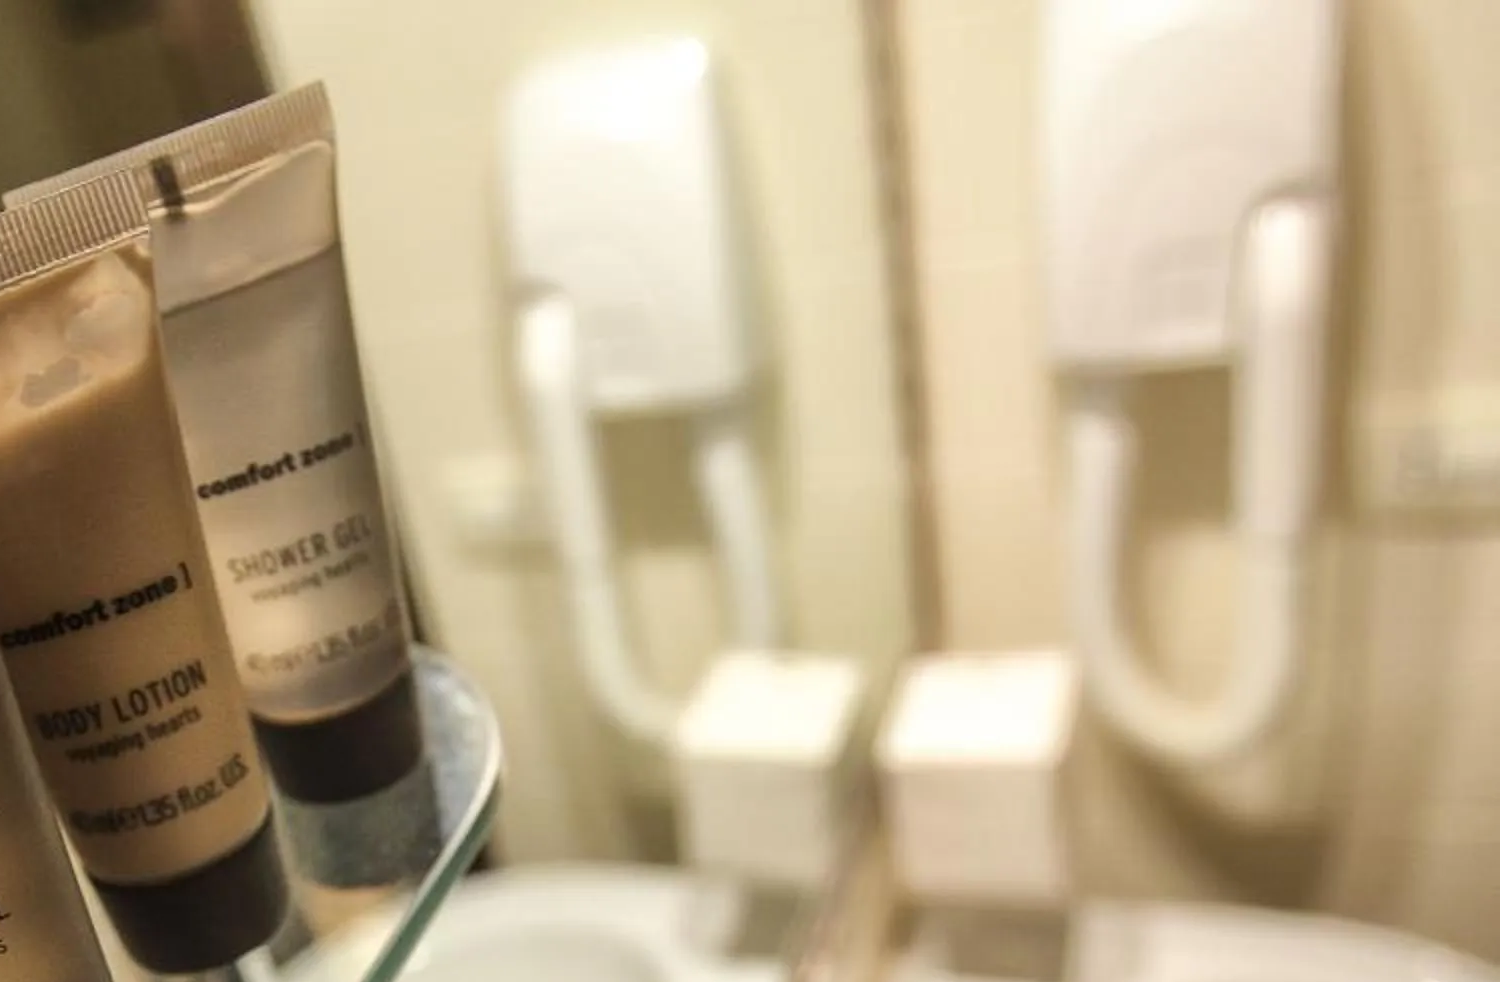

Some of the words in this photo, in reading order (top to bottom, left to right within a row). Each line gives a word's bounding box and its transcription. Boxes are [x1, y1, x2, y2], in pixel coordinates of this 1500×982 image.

[197, 451, 297, 499] comfort
[299, 432, 354, 468] zone
[227, 532, 330, 585] SHOWER
[332, 513, 372, 550] GEL
[0, 600, 110, 649] comfort
[112, 574, 178, 616] zone
[35, 703, 102, 741] BODY
[111, 659, 209, 724] LOTION
[146, 705, 202, 740] hearts
